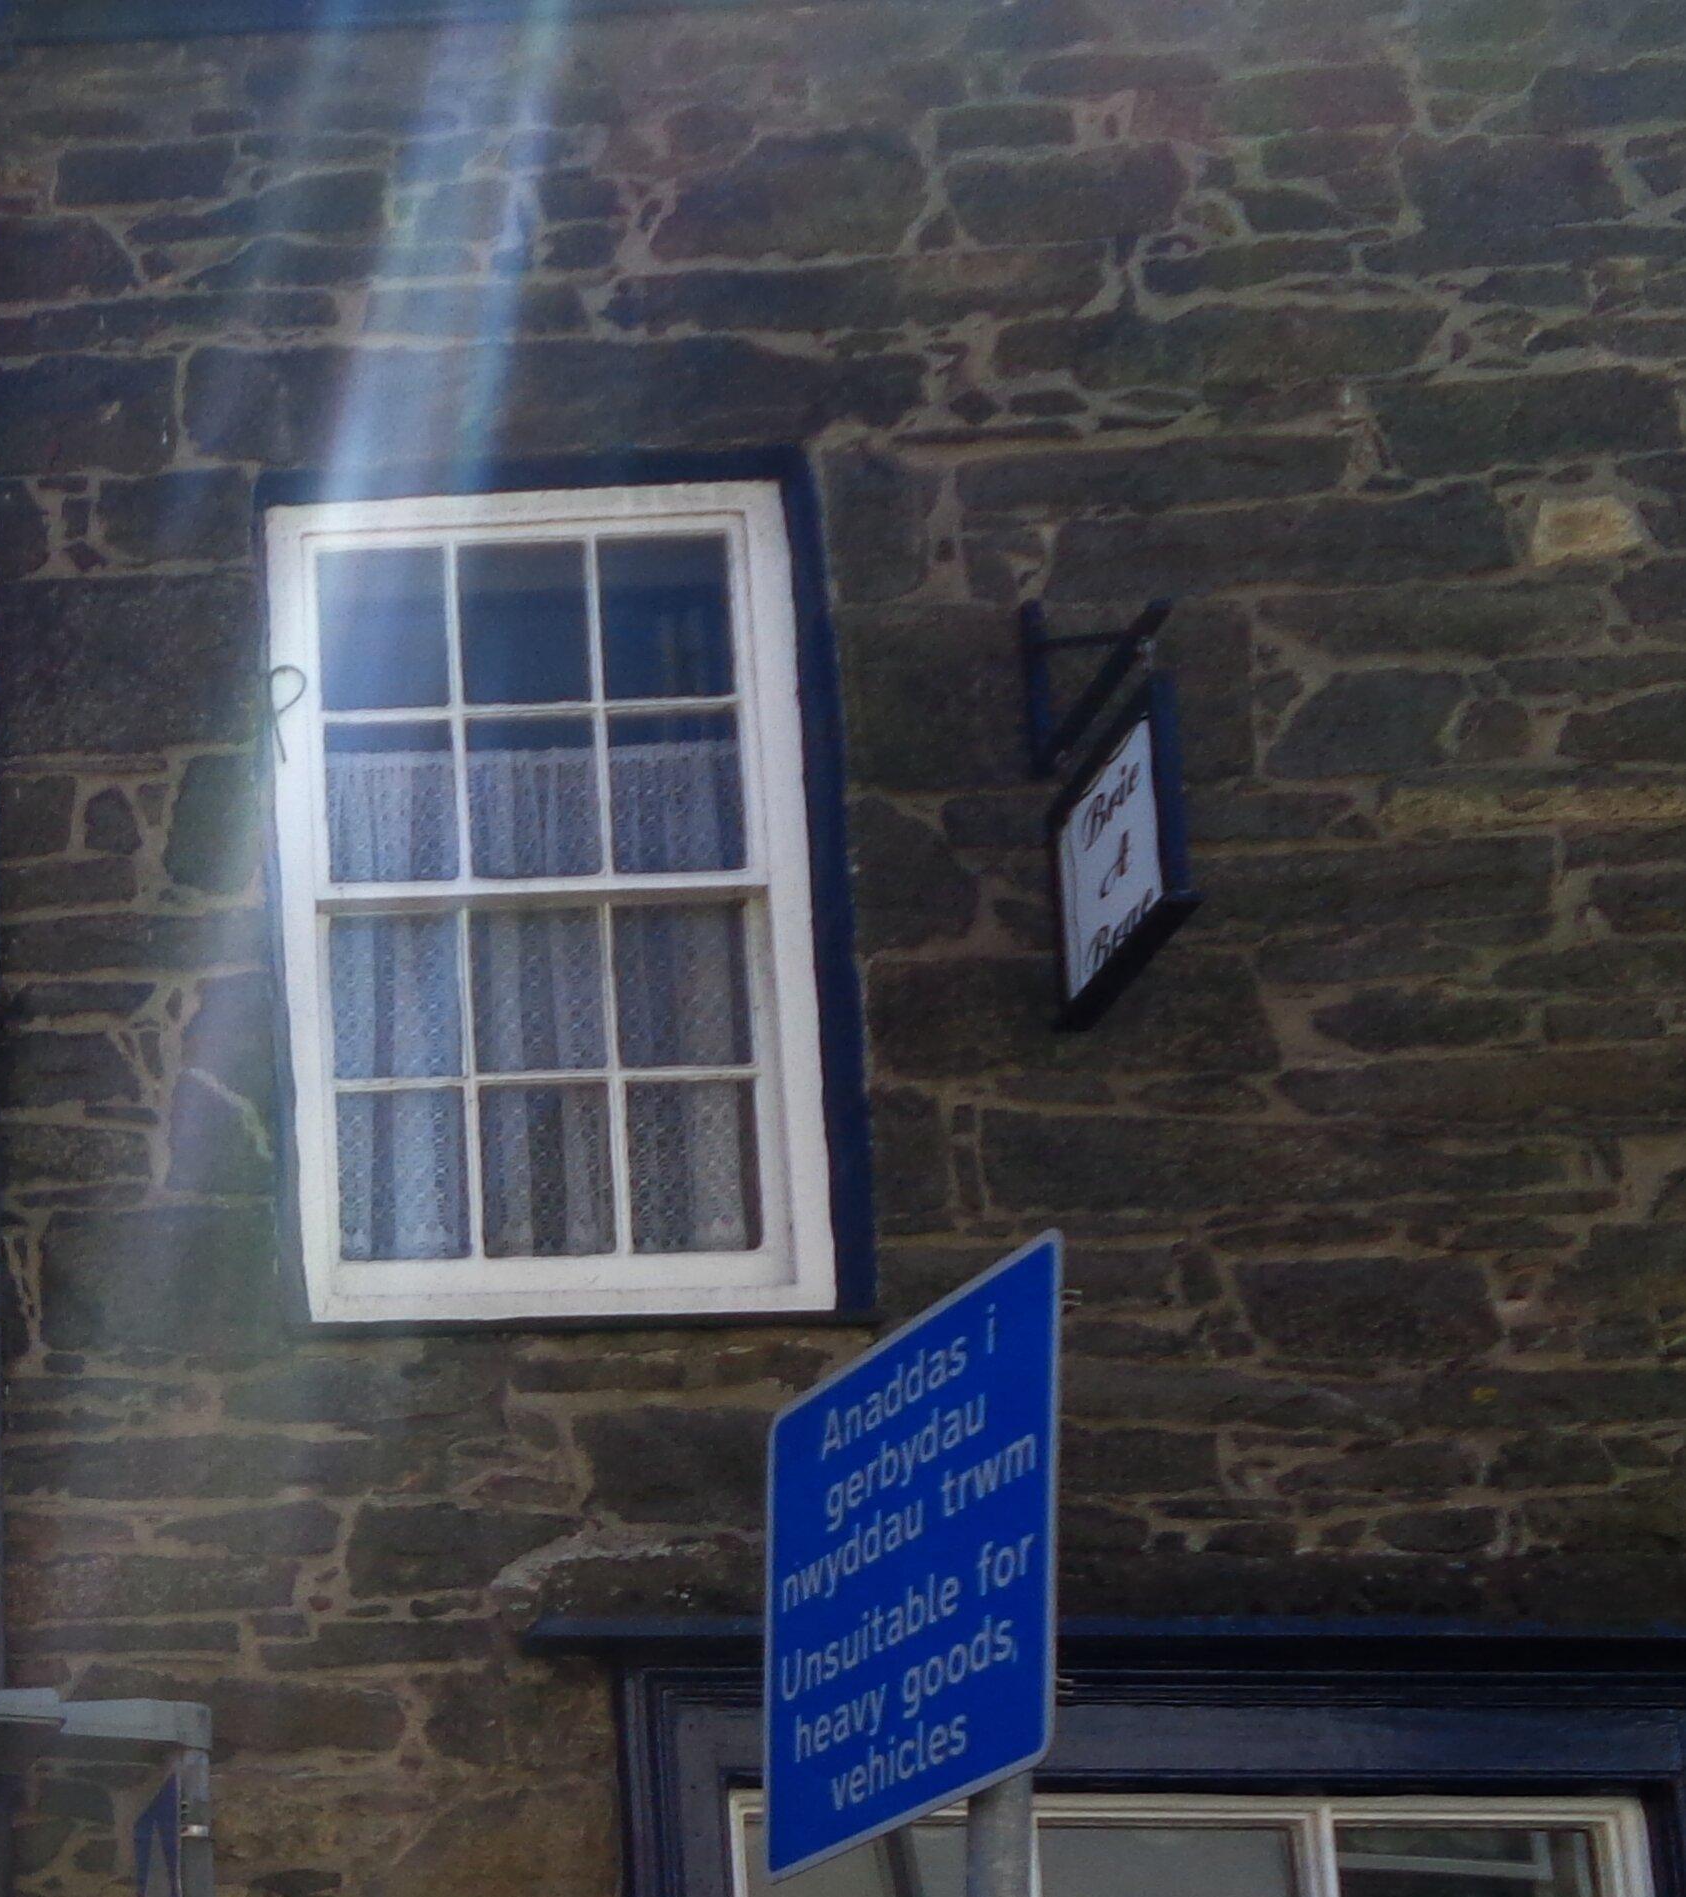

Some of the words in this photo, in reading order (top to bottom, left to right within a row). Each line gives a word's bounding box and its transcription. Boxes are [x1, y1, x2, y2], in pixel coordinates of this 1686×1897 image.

[820, 1335, 969, 1462] Anaddas
[985, 1302, 997, 1355] i
[781, 1499, 925, 1613] nwyddau
[940, 1432, 1037, 1517] trwm
[826, 1392, 986, 1532] gerbydau
[781, 1573, 962, 1702] Unsuitable
[977, 1532, 1036, 1597] for
[794, 1682, 888, 1764] heavy
[830, 1714, 968, 1811] vehicles
